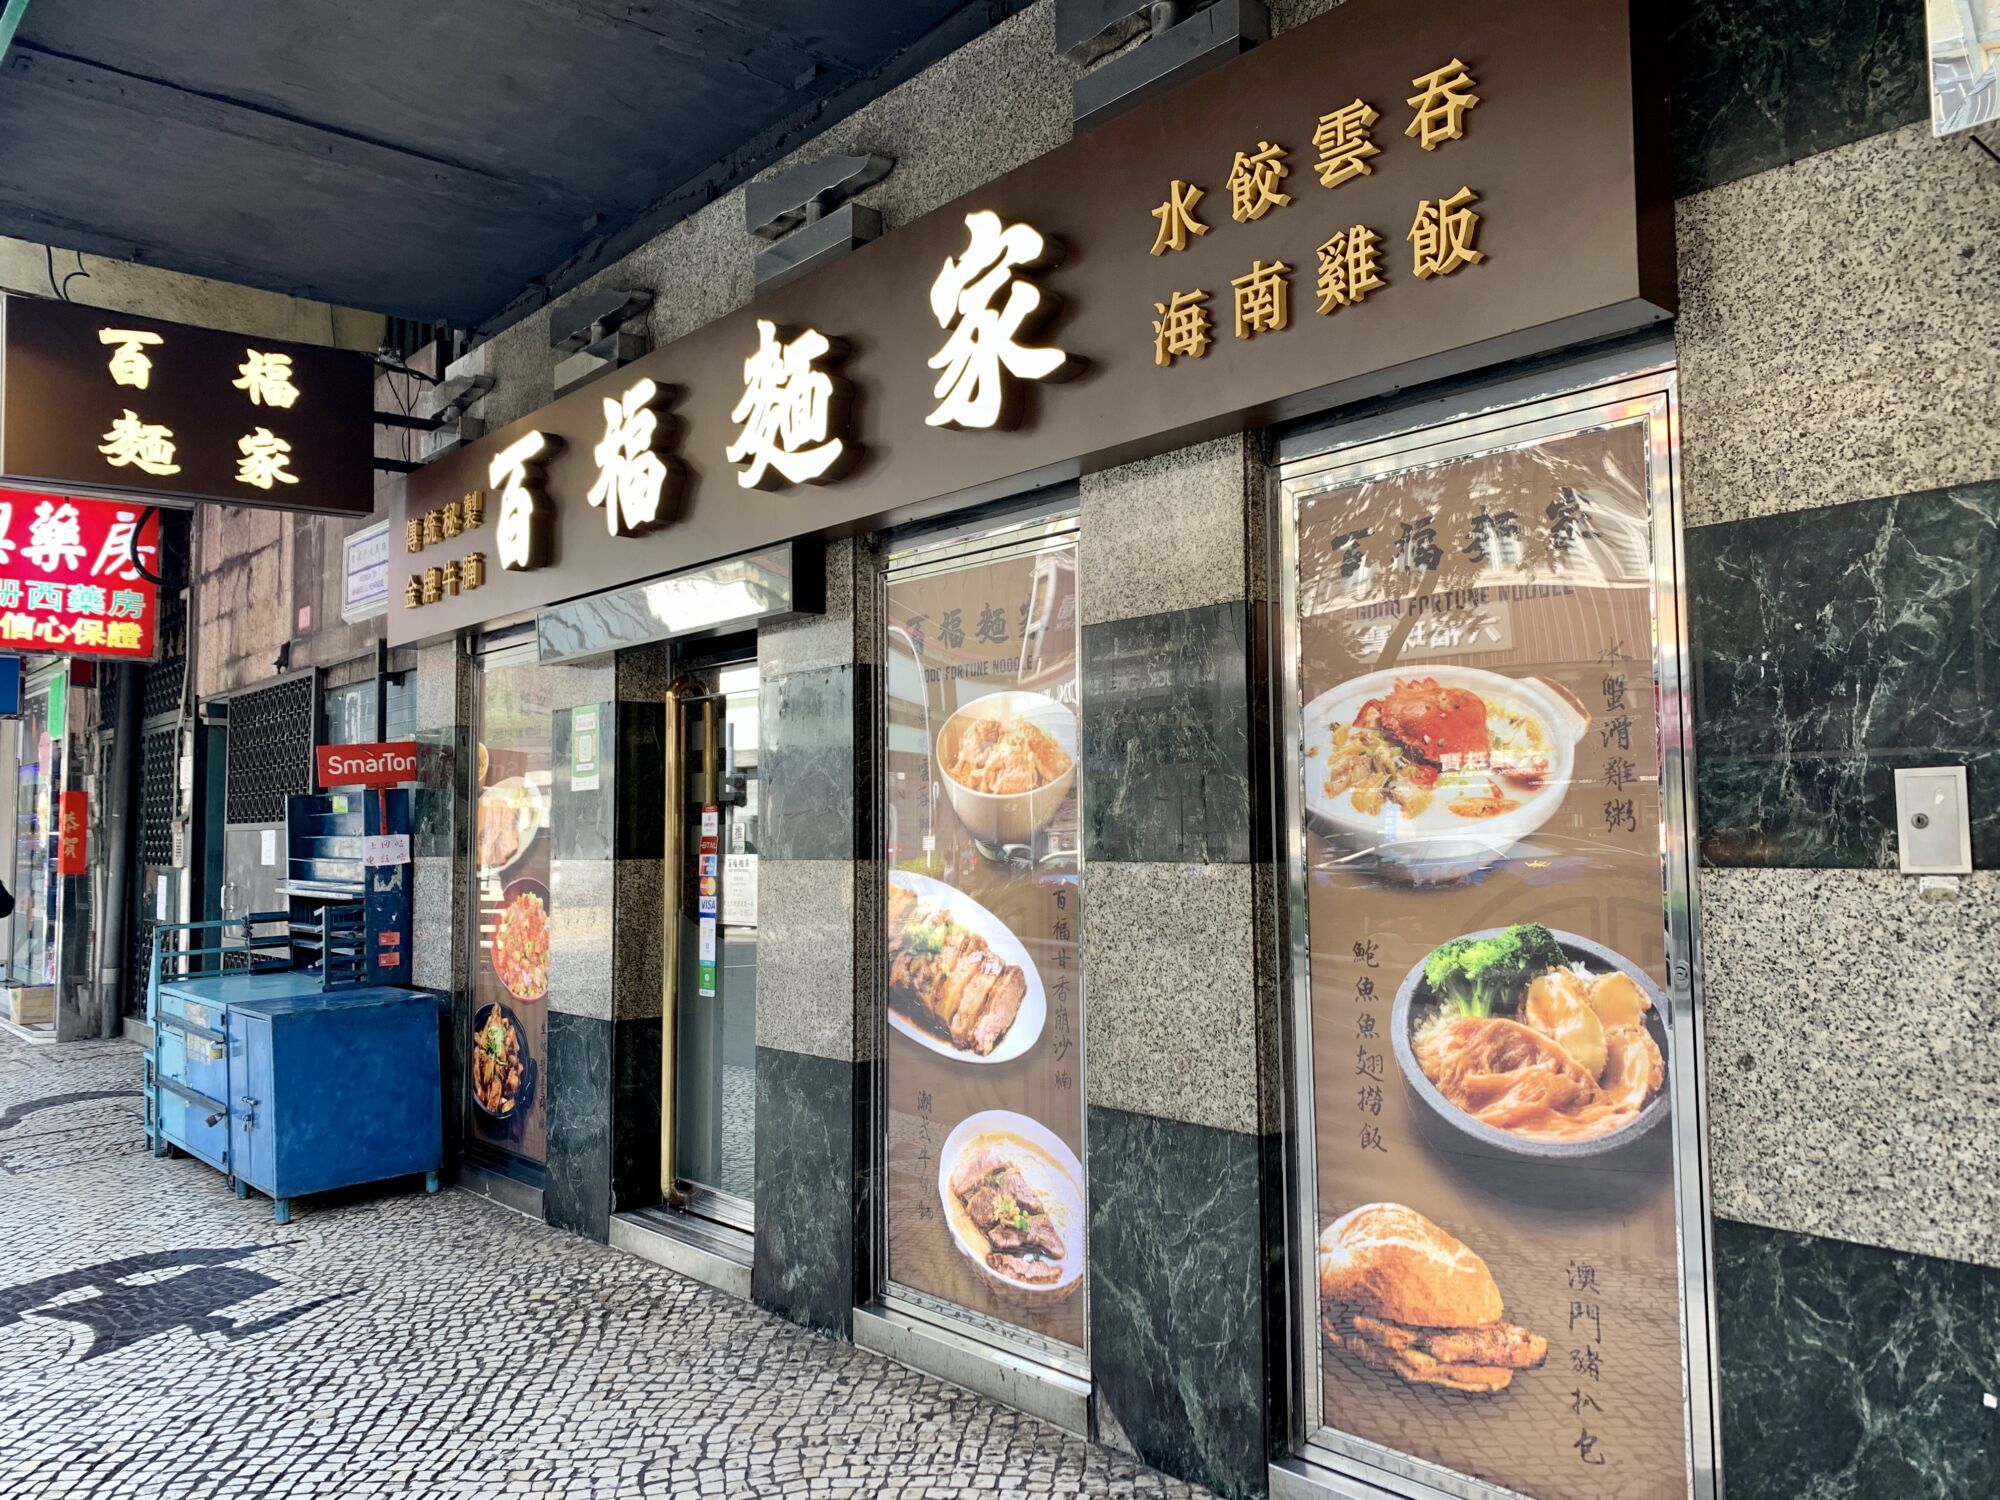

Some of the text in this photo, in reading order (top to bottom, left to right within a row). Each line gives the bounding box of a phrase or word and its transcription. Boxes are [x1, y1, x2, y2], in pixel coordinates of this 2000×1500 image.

[1150, 57, 1480, 257] 水餃雲吞
[1152, 186, 1485, 367] 海南雞飯
[98, 327, 300, 409] 百福
[489, 209, 1067, 571] 百福麵家
[97, 408, 300, 489] 麵家
[406, 490, 484, 553] 傳統秘製
[405, 551, 484, 609] 金牌牛腩
[1408, 586, 1491, 617] FORTUNE
[945, 661, 990, 680] FORTUNE
[701, 899, 716, 910] VISA
[1352, 939, 1388, 1153] 鮑魚魚翅撈飯
